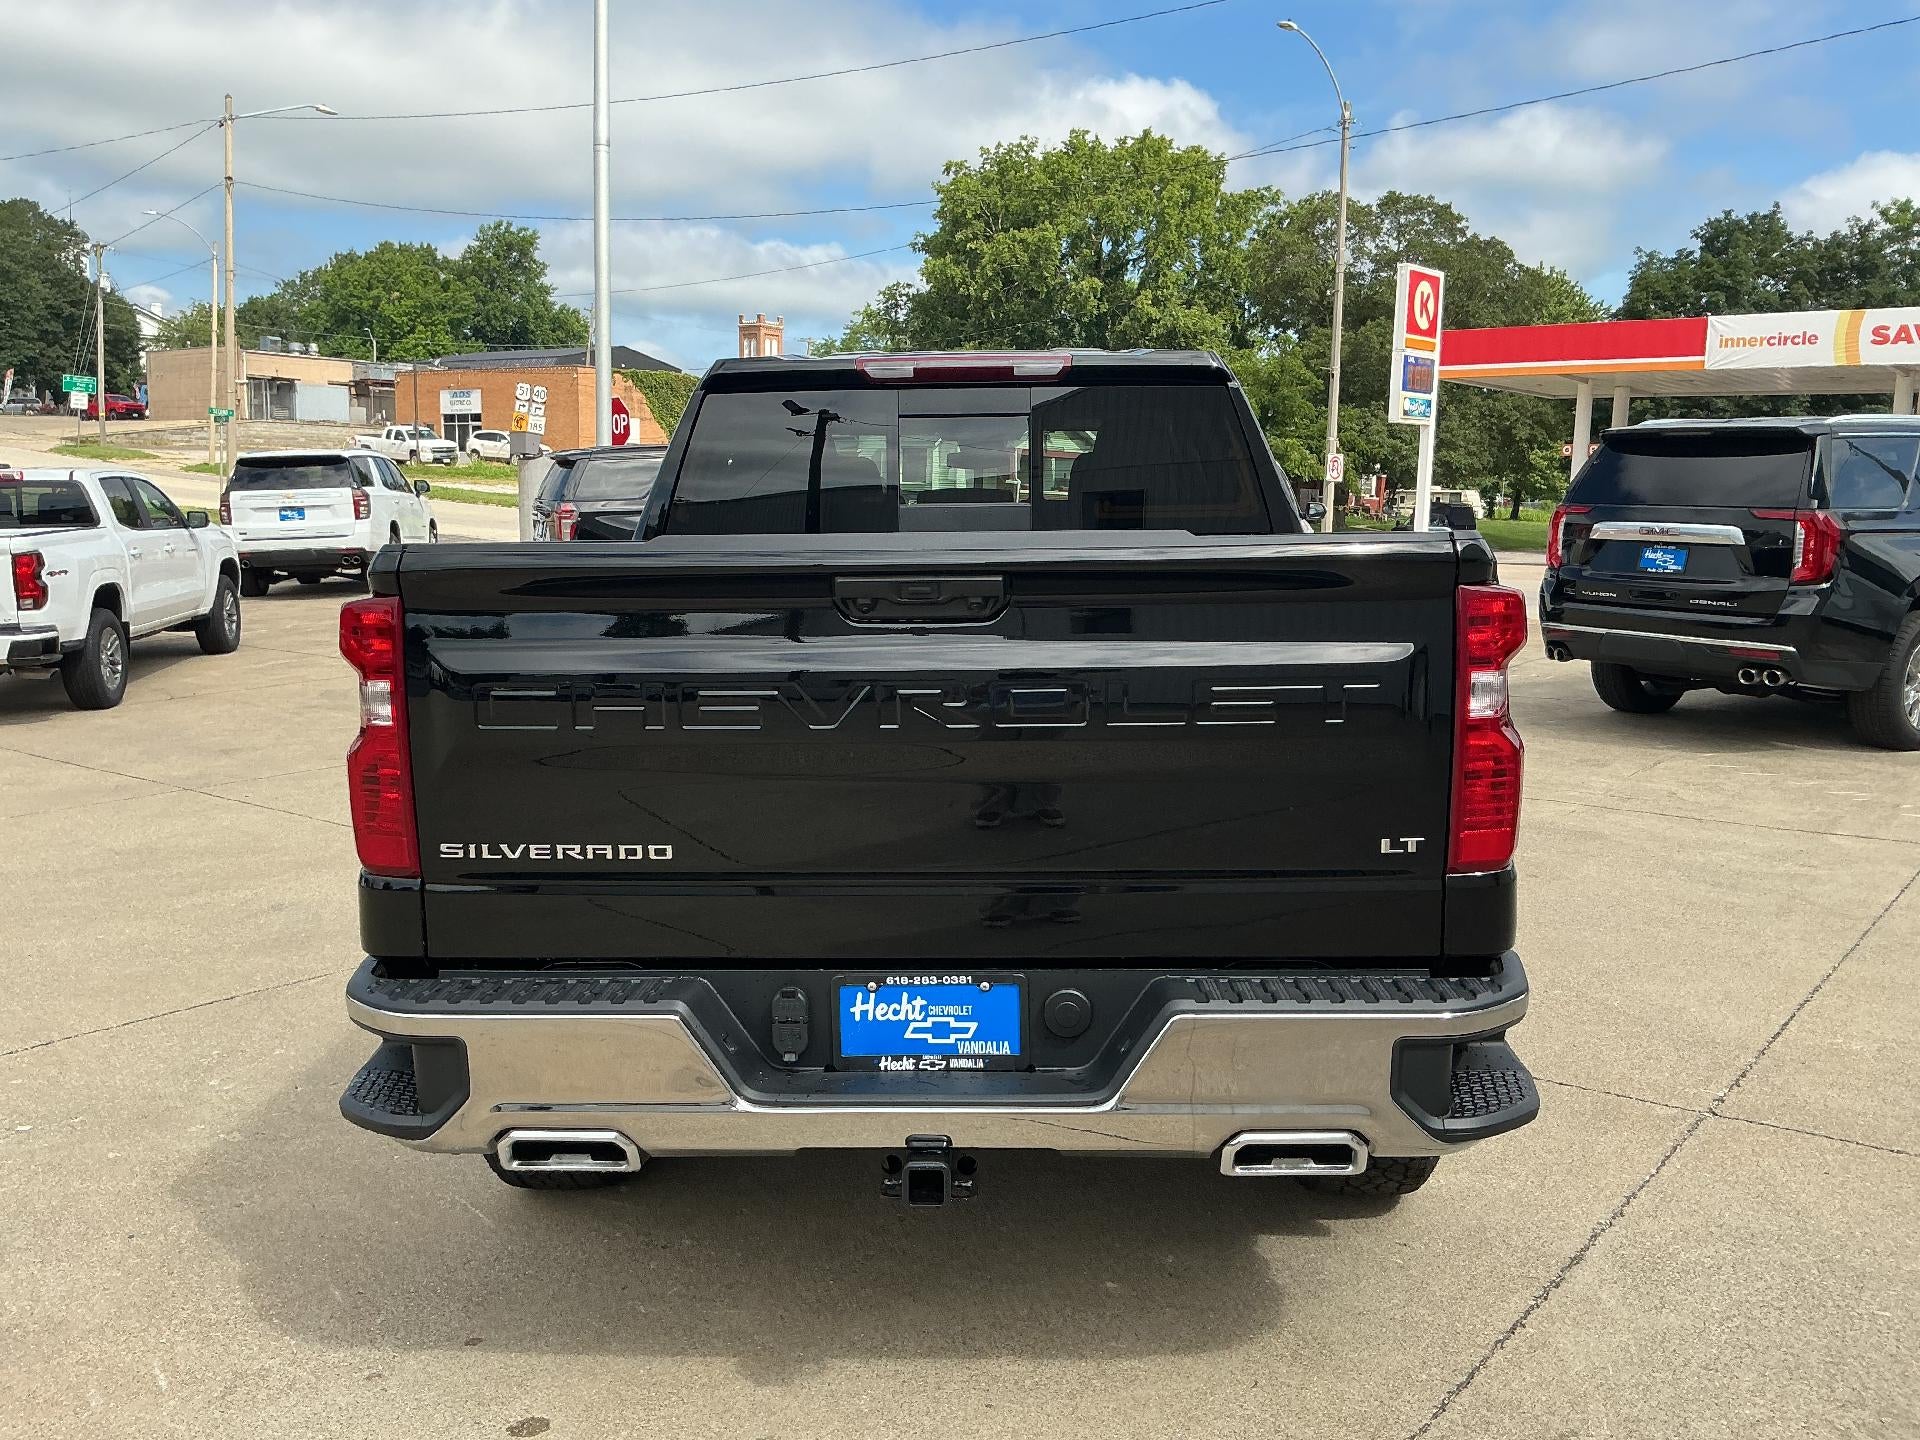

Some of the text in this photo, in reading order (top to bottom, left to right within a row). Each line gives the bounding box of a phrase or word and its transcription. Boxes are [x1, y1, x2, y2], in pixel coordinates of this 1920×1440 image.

[1419, 290, 1431, 325] K
[1718, 330, 1819, 349] innercircle
[519, 386, 529, 396] 51
[534, 389, 546, 400] 40
[612, 413, 628, 435] OP
[1639, 526, 1680, 536] GMC
[1582, 590, 1617, 598] YUKON
[1689, 599, 1738, 607] DENALI
[474, 677, 1382, 731] CHEVROLET
[439, 843, 673, 860] SILVERADO
[1381, 837, 1425, 853] LT
[886, 975, 973, 985] 618-283-0381
[850, 991, 973, 1022] Hecht CHEVROLET
[957, 1040, 1011, 1055] VANDALIA
[879, 1056, 984, 1071] Hecht VANDALIA
